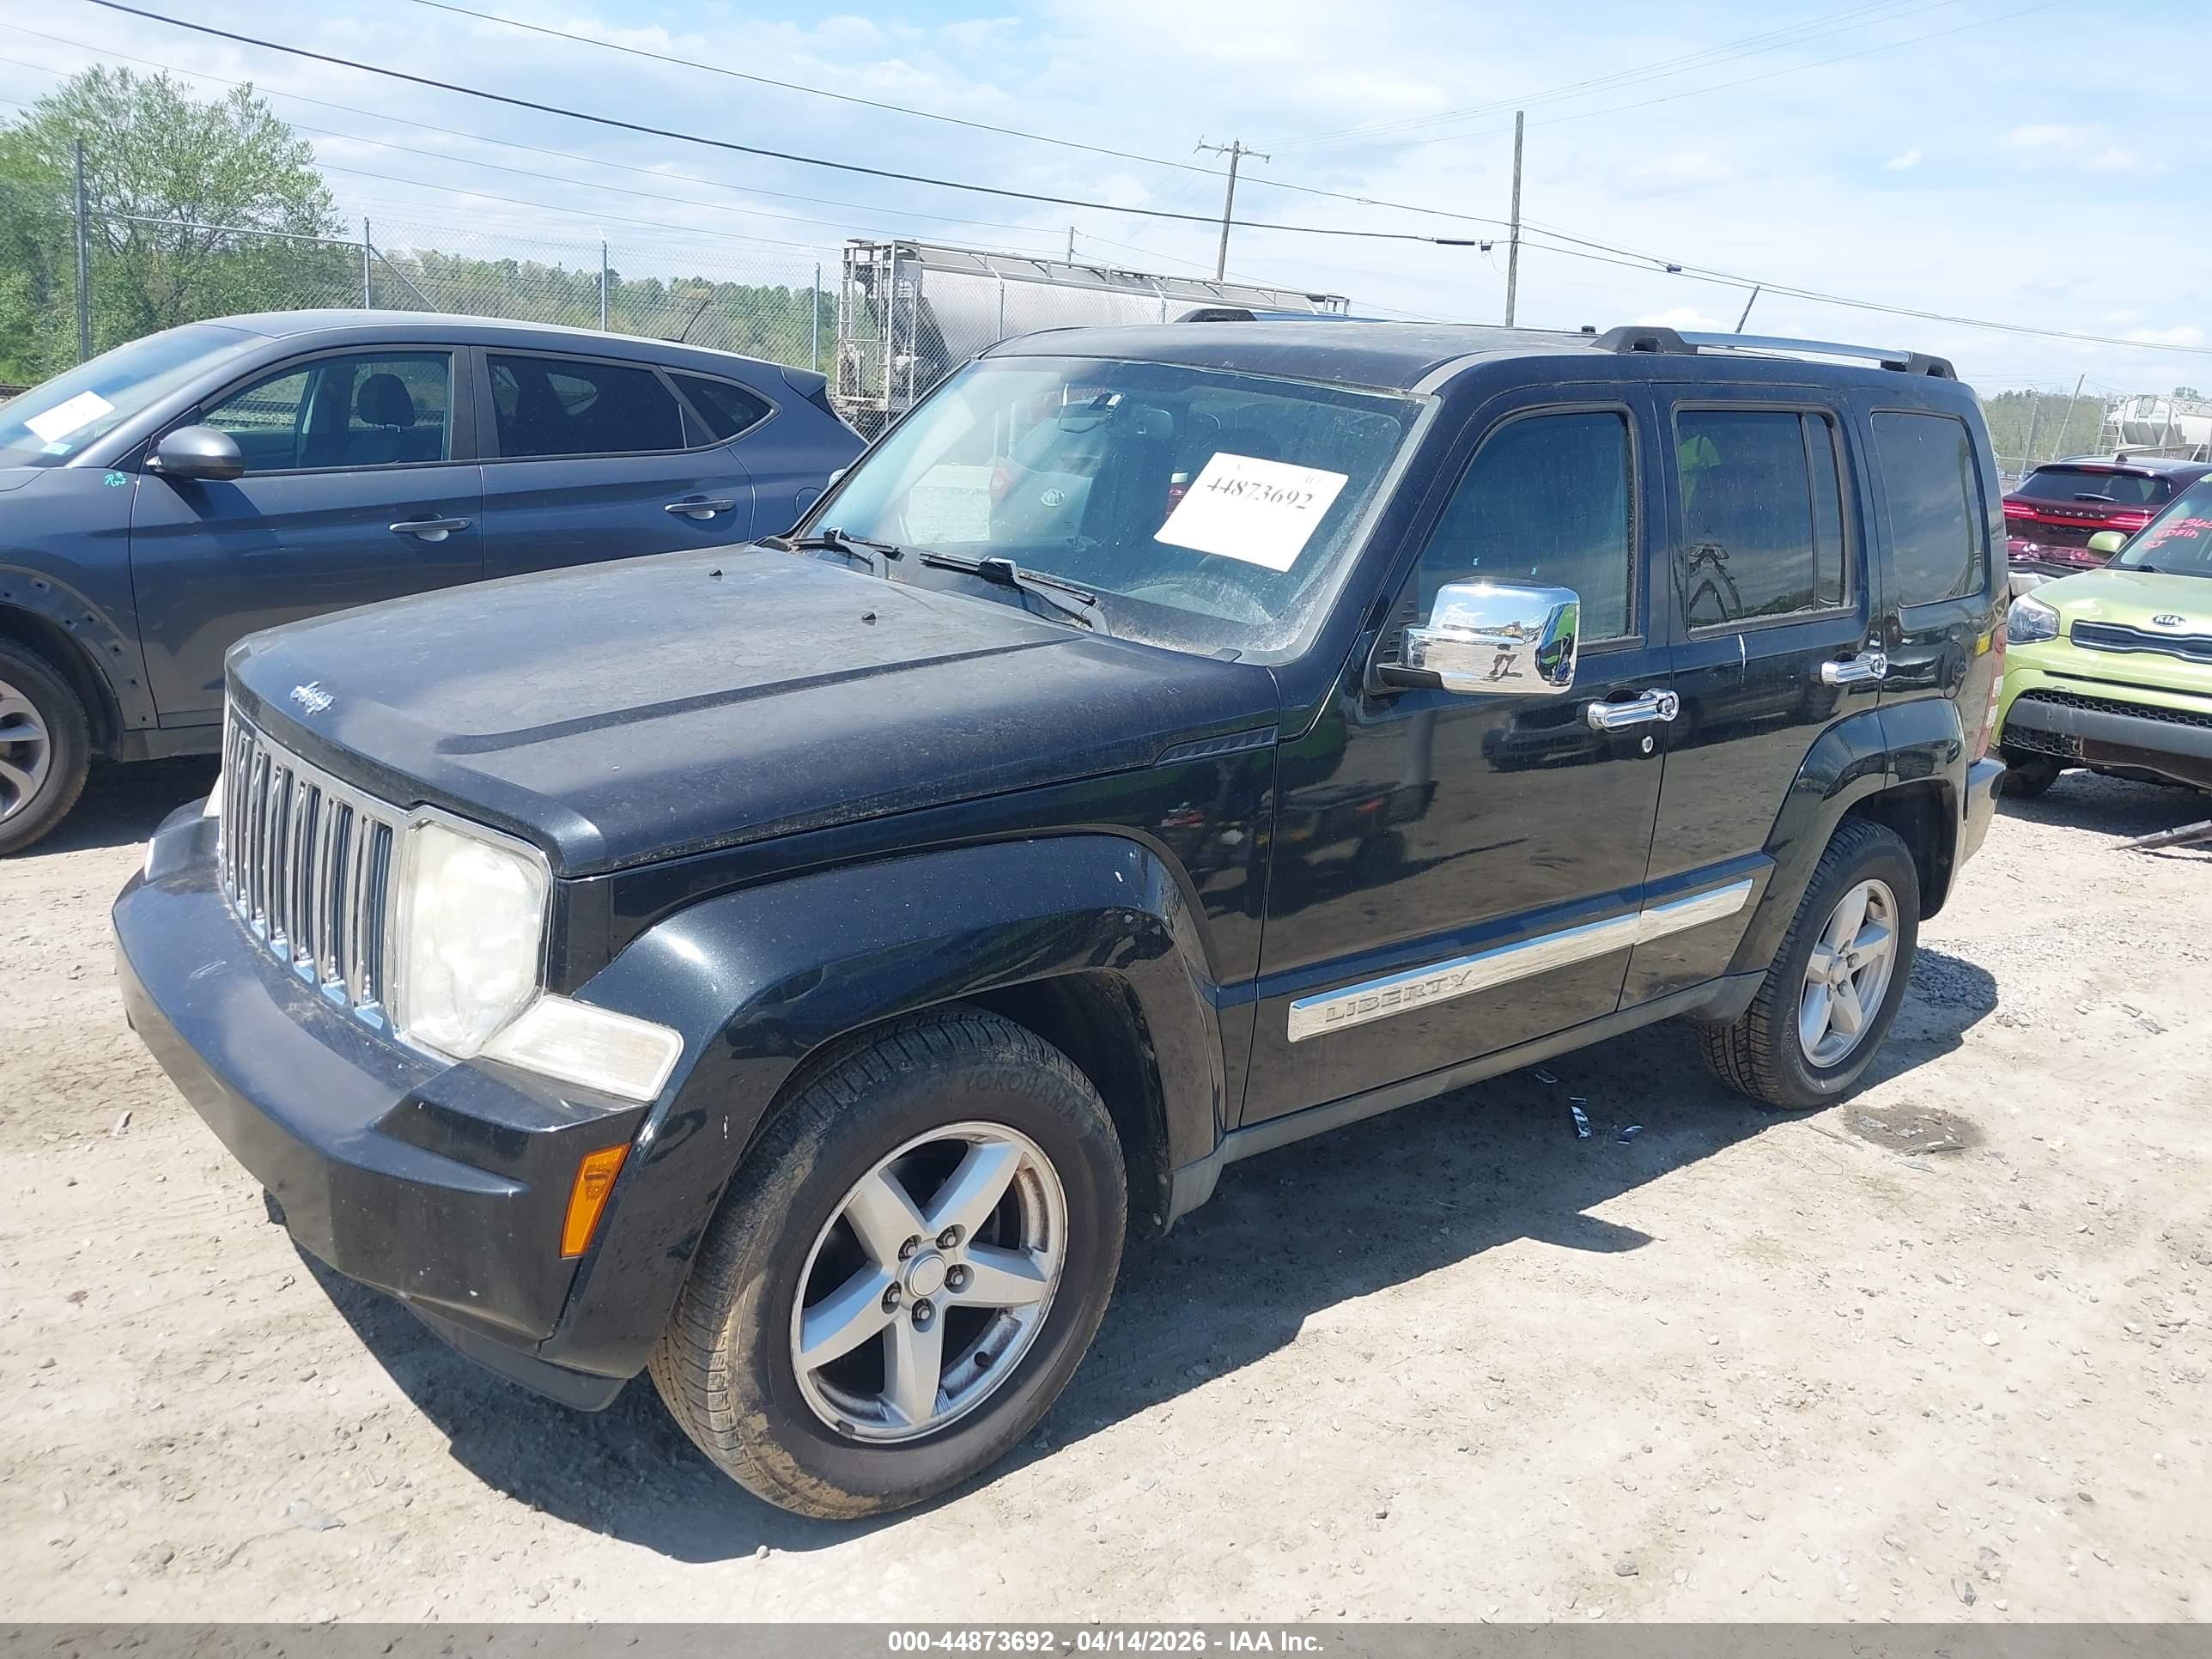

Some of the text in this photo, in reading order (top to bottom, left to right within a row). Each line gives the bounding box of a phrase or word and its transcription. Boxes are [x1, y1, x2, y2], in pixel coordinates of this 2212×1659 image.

[1206, 476, 1314, 510] 44873692
[2036, 507, 2106, 520] LINCOLN
[1325, 969, 1473, 1023] LIBERTY
